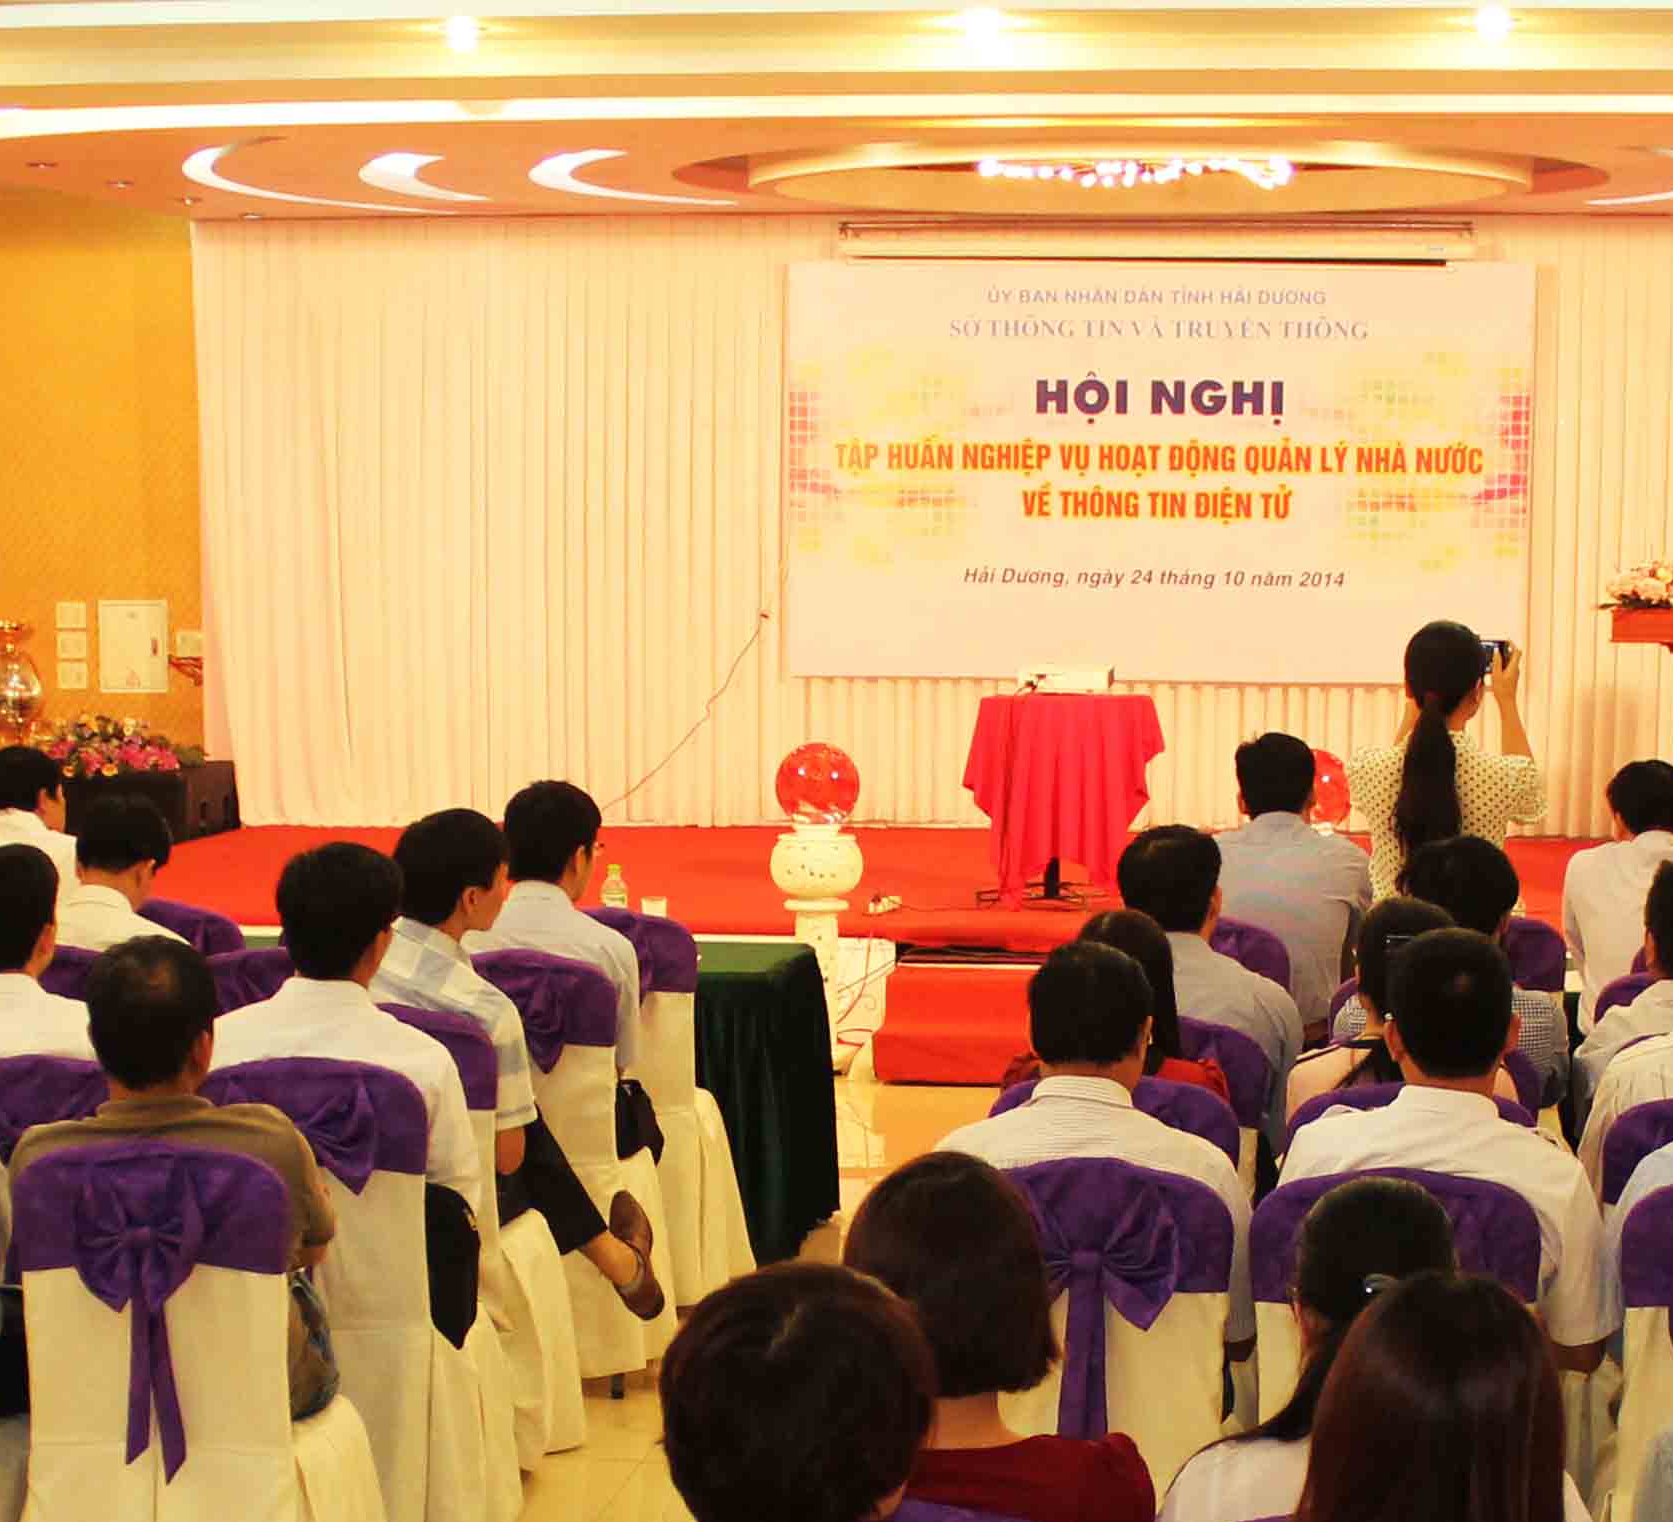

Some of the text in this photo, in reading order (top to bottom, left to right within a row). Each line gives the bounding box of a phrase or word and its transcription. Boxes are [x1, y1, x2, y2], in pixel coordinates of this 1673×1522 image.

[1020, 290, 1056, 304] BAN
[1085, 319, 1124, 337] TIN
[1035, 371, 1283, 425] HỘI NGHỊ
[836, 434, 1484, 477] TẬP HUẤN NGHIỆP VỤ HOẠT ĐỘNG QUẢN LÝ NHÀ NƯỚC
[1022, 481, 1293, 525] VỀ THÔNG TIN ĐIỆN TỬ
[1077, 570, 1125, 589] ngày
[1130, 569, 1155, 585] 24
[1159, 570, 1215, 590] tháng
[1224, 571, 1244, 586] 10
[1250, 571, 1293, 588] năm
[1299, 572, 1346, 588] 2014
